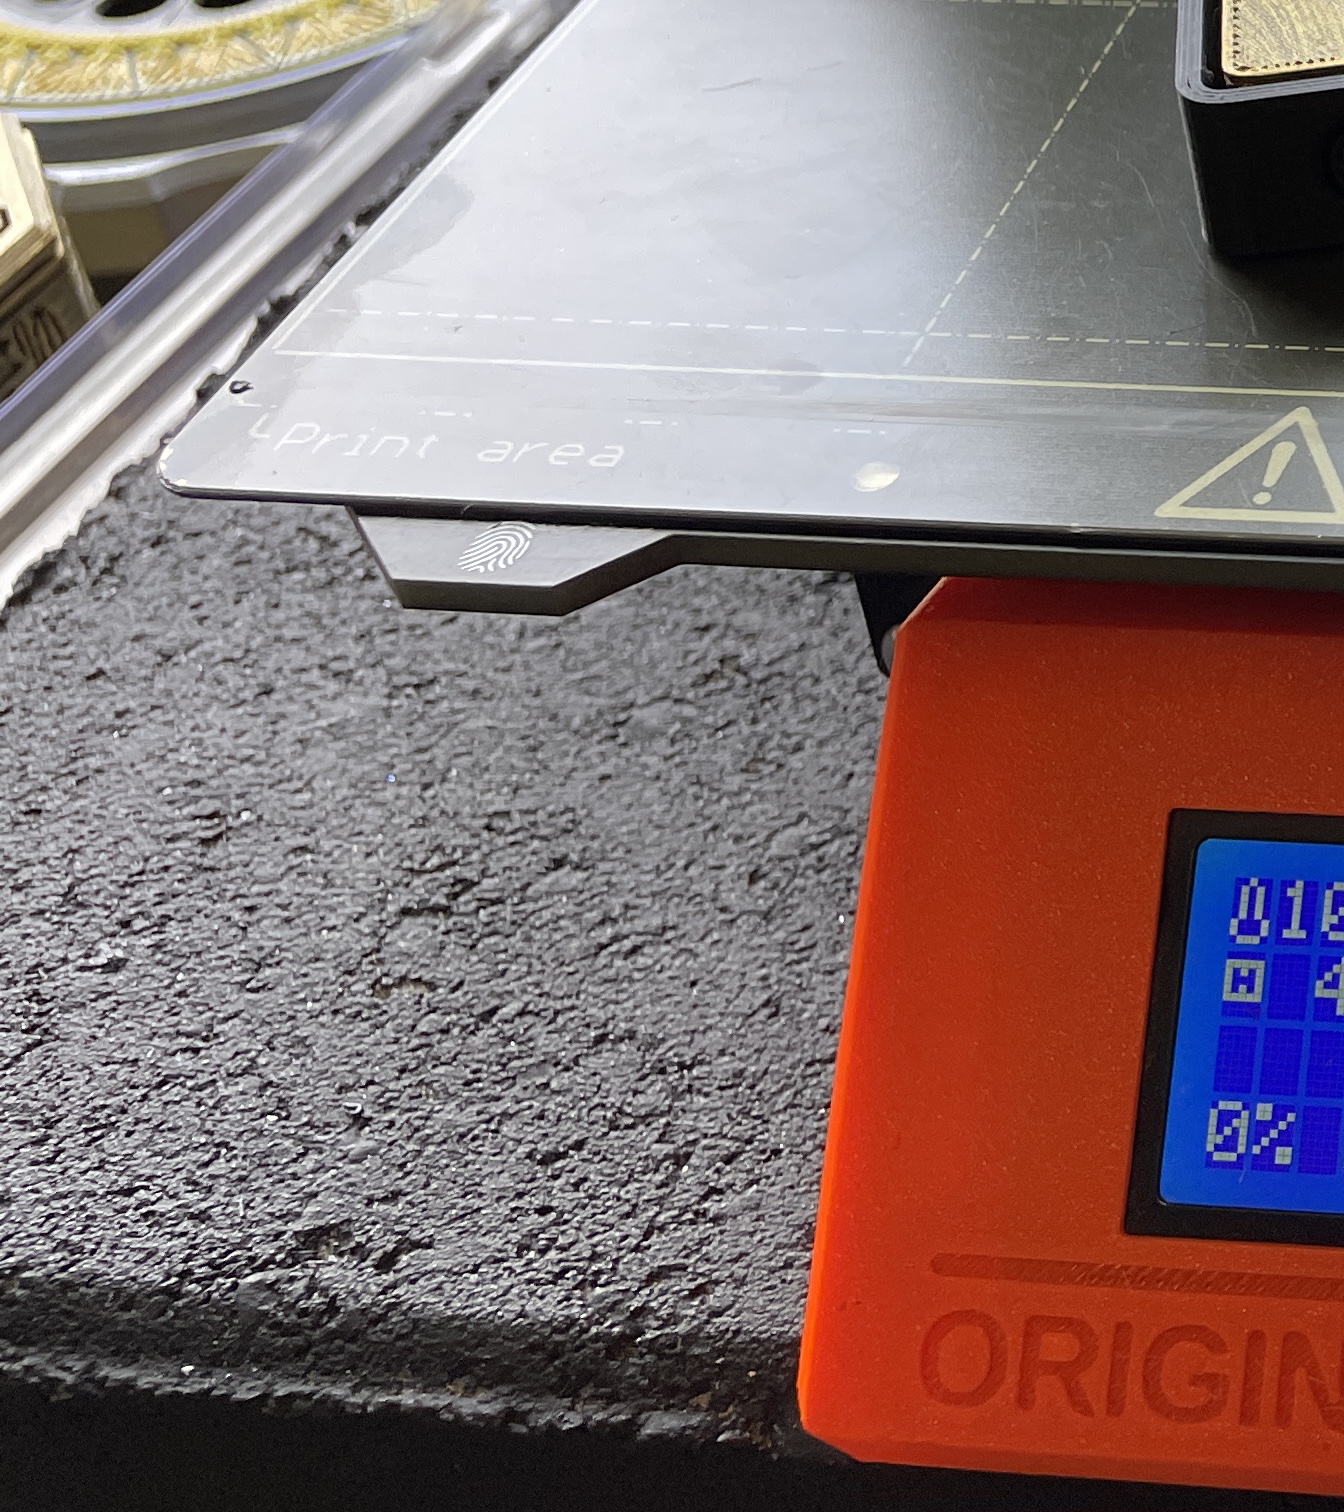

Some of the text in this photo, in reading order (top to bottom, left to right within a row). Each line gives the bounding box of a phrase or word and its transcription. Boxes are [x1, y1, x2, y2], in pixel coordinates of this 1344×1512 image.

[273, 420, 628, 468] Print area
[1205, 1100, 1297, 1165] 0%
